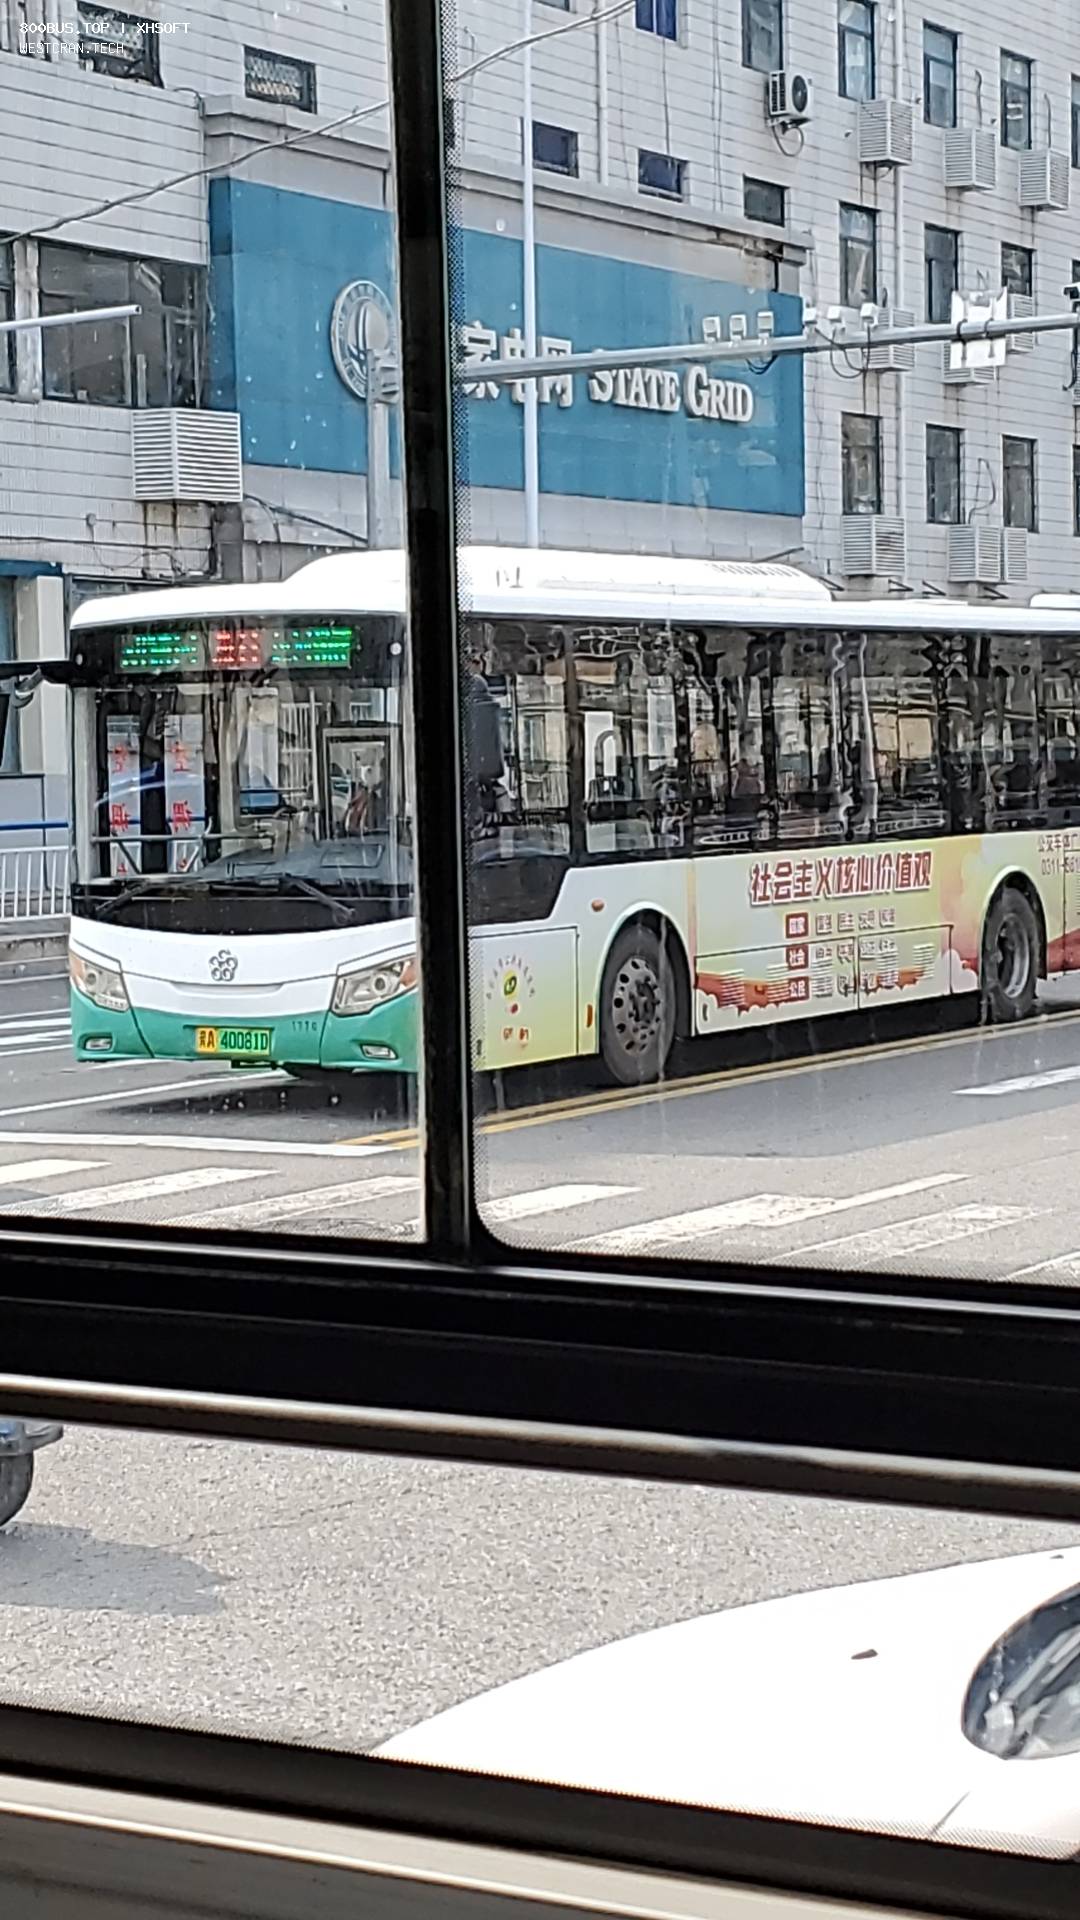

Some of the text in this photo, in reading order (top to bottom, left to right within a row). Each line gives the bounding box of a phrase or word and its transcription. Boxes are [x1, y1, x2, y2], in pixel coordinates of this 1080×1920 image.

[751, 850, 933, 906] 社会主义核心价值观
